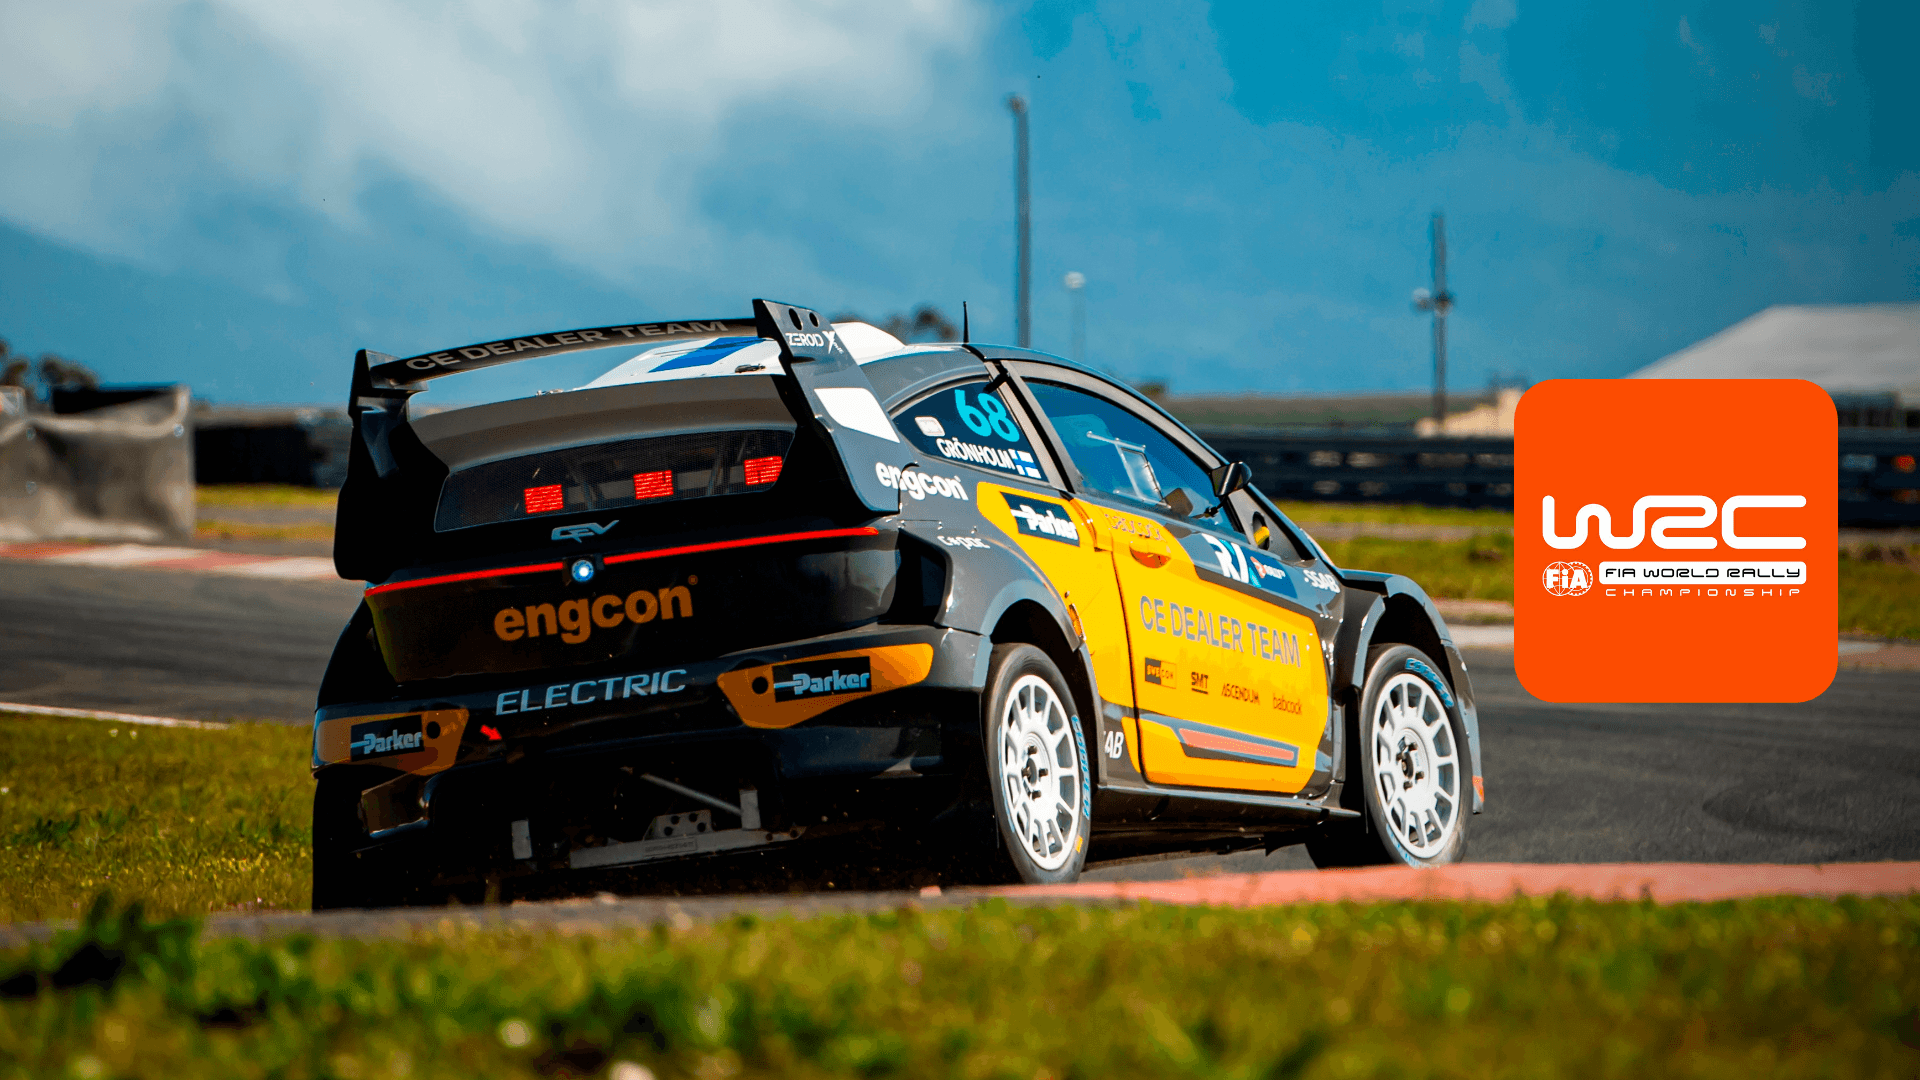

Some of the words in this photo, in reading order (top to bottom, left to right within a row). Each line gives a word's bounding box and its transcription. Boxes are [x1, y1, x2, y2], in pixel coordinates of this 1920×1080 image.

[405, 352, 461, 370] CE
[458, 330, 610, 361] DEALER
[611, 321, 729, 338] TEAM
[954, 389, 1020, 442] 68
[936, 436, 1016, 470] GRÖNHOLM
[875, 462, 969, 501] engcon
[1010, 504, 1079, 541] Parker
[494, 585, 694, 644] engcon
[1140, 595, 1167, 634] CE
[1169, 602, 1244, 654] DEALER
[1246, 622, 1301, 668] TEAM
[495, 669, 687, 716] ELECTRIC
[773, 669, 870, 695] Parker
[1191, 671, 1209, 690] SMT
[350, 729, 422, 755] Parker
